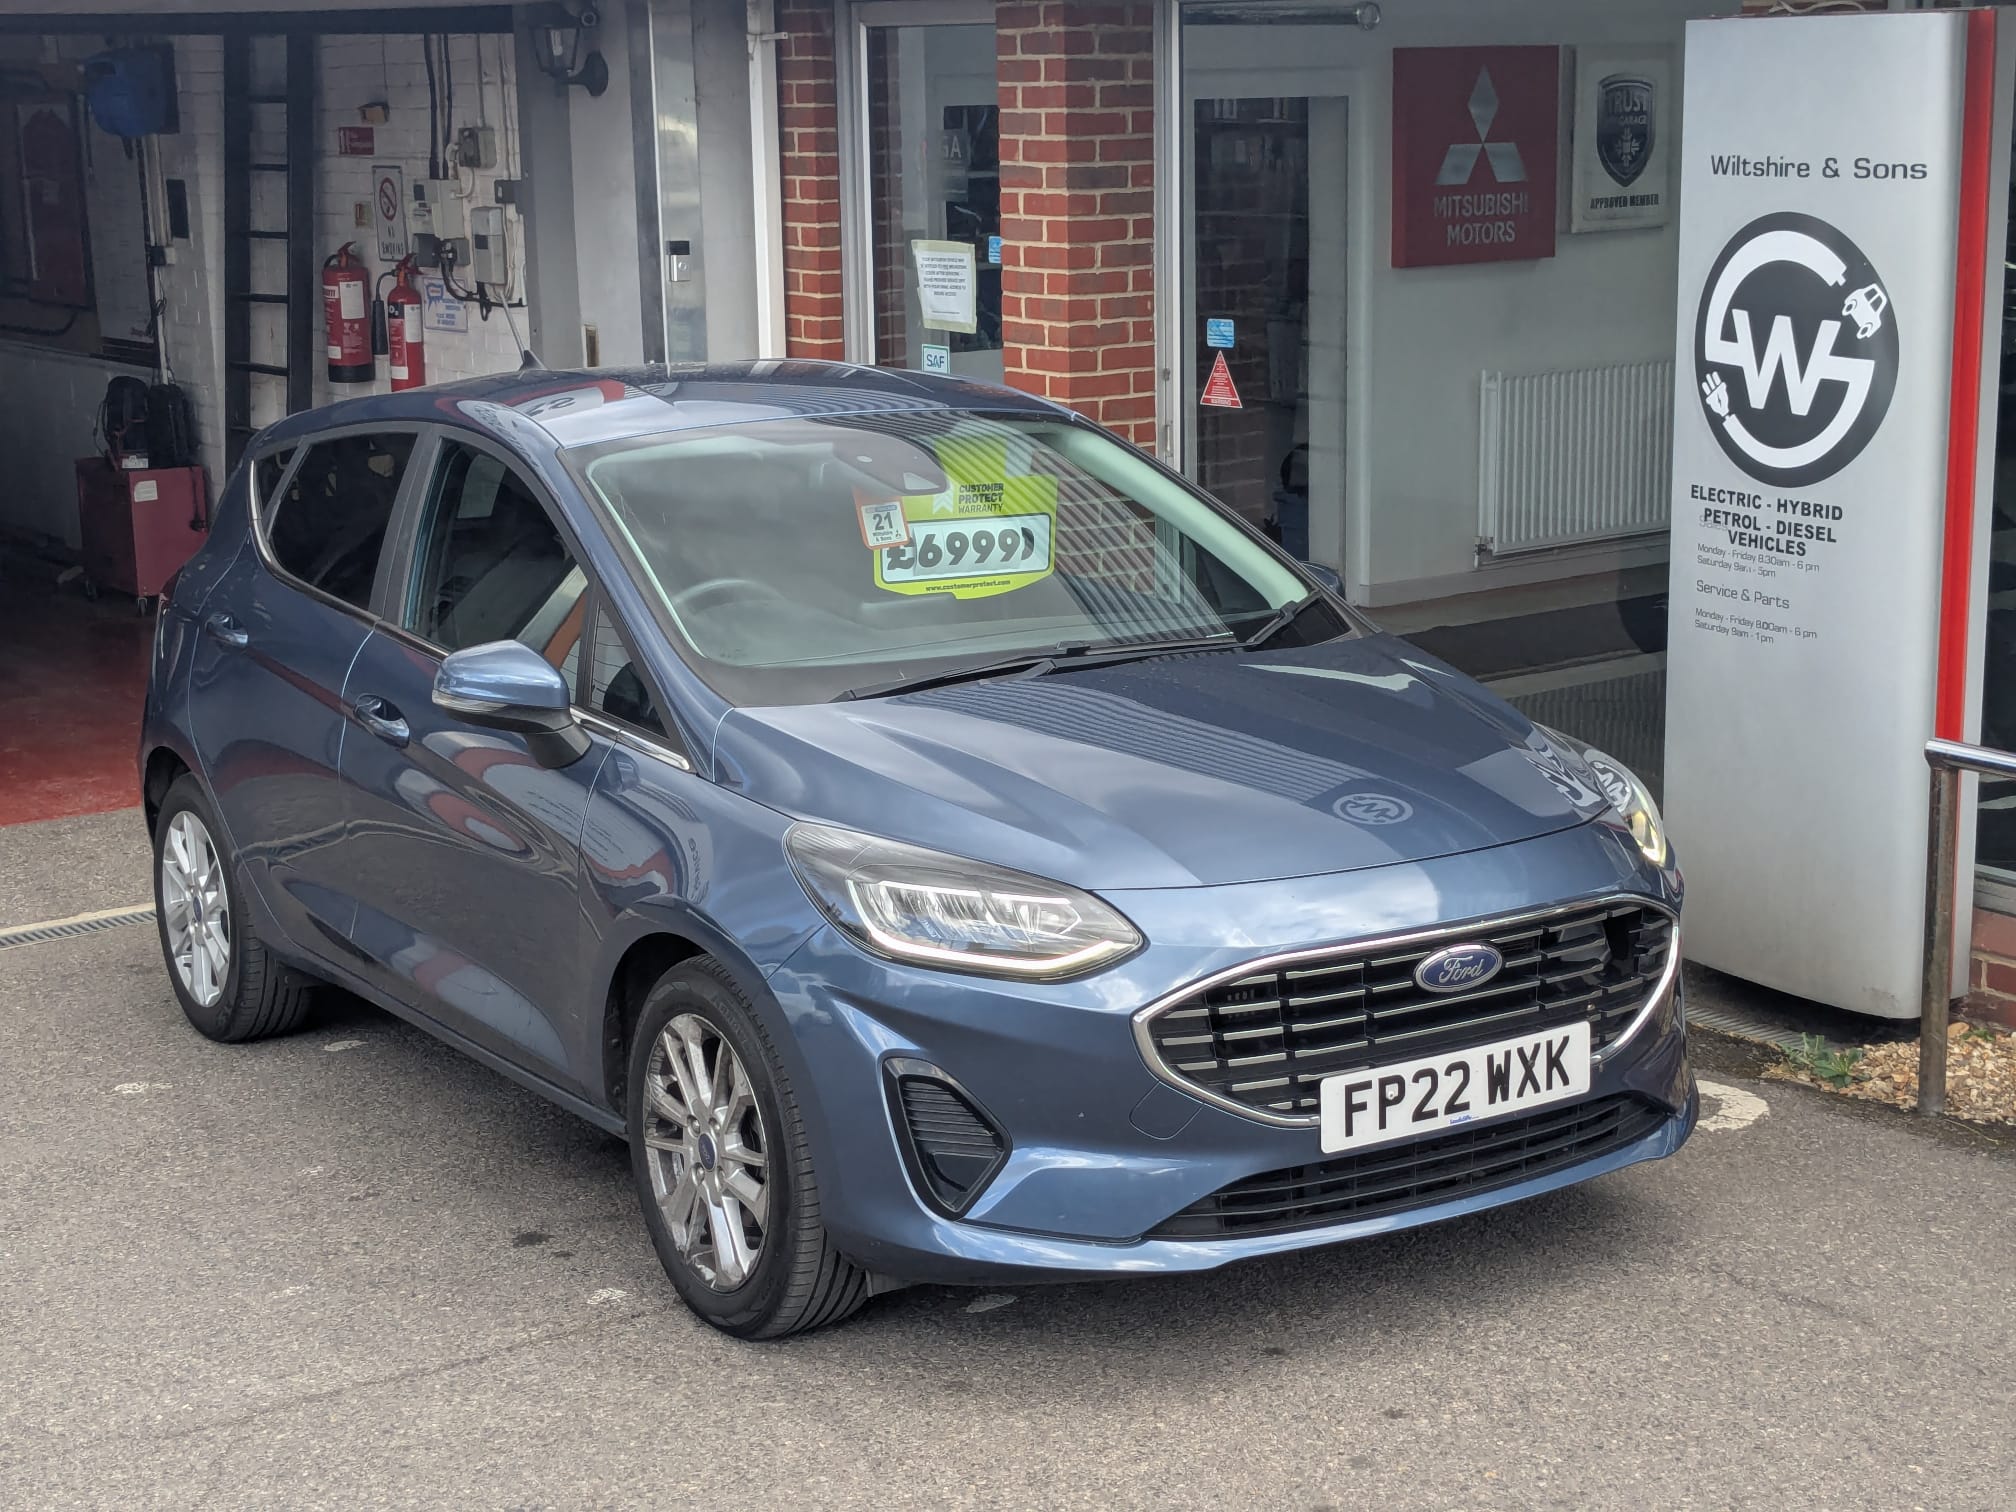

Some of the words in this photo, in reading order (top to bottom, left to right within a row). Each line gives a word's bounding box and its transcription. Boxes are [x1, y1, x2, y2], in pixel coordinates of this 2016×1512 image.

[1608, 90, 1648, 114] TRUST
[1710, 154, 1811, 179] Wiltshire
[1821, 157, 1841, 179] &
[1853, 157, 1928, 180] Sons
[1434, 191, 1529, 218] MITSUBISHI
[1589, 195, 1628, 209] APPROVED
[1629, 193, 1660, 207] MEMBER
[1447, 220, 1516, 247] MOTORS
[926, 353, 945, 368] SAF
[959, 482, 1004, 493] CUSTOMER
[959, 492, 1004, 504] PROTECT
[958, 502, 1004, 513] WARRANTY
[1691, 484, 1762, 509] ELECTRIC
[1776, 498, 1843, 521] HYBRID
[872, 511, 893, 531] 21
[1703, 507, 1761, 532] PETROL
[1776, 519, 1837, 543] DIESEL
[1697, 543, 1726, 558] Monday
[1732, 549, 1756, 563] Friday
[1728, 529, 1807, 557] VEHICLES
[1697, 555, 1732, 571] Saturday
[1696, 579, 1738, 600] Service
[1740, 588, 1751, 602] &
[1754, 591, 1790, 609] Parts
[1694, 619, 1729, 636] Saturday
[1695, 607, 1724, 624] Monday
[1729, 614, 1754, 628] Friday
[1439, 954, 1485, 984] Ford
[1344, 1060, 1471, 1138] FP22
[1486, 1034, 1571, 1106] WXK
